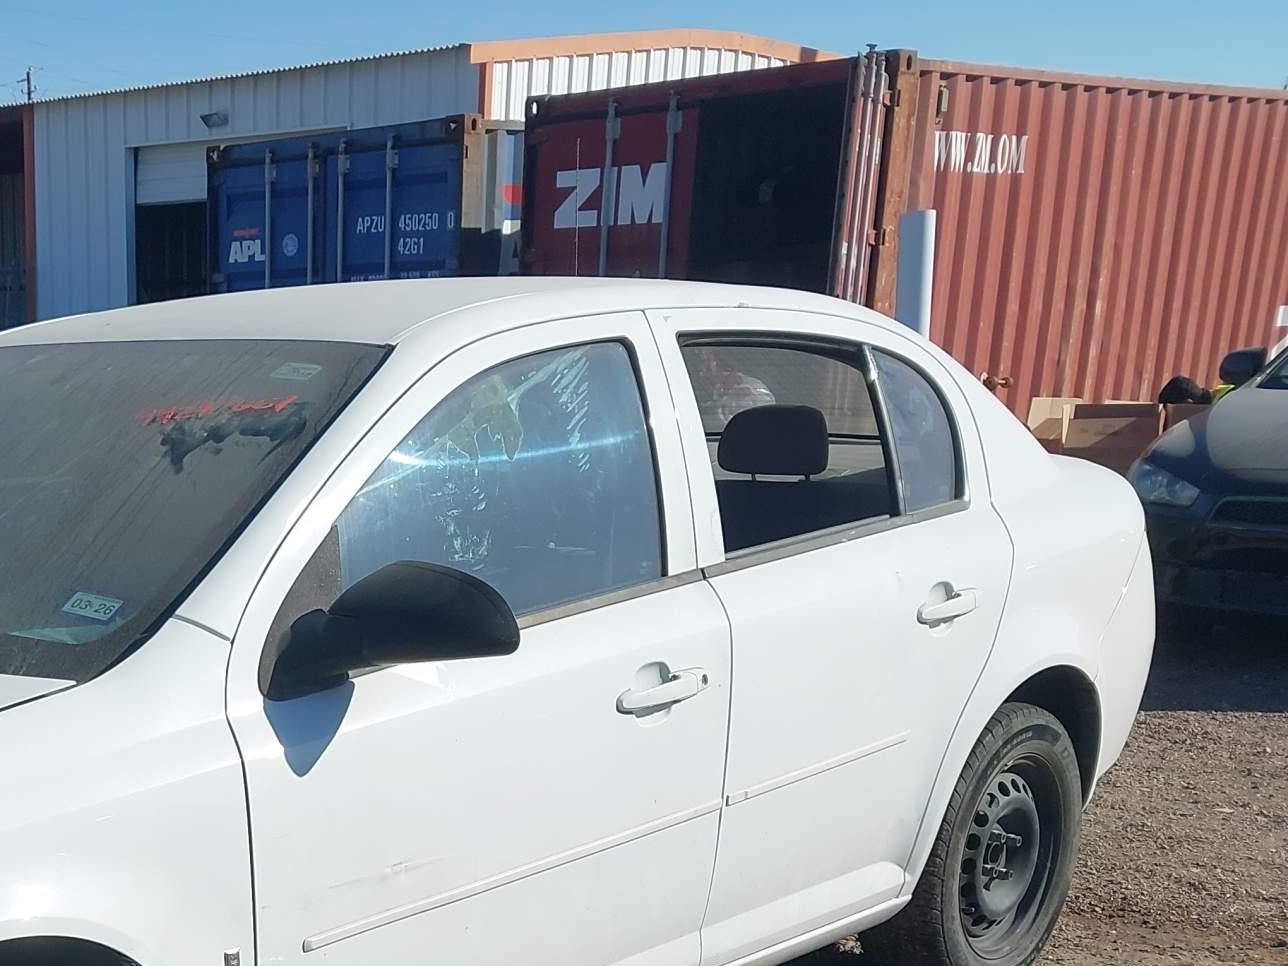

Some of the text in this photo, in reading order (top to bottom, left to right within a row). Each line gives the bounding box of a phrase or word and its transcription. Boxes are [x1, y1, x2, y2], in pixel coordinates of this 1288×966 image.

[553, 162, 668, 229] ZIM
[356, 215, 385, 233] APZU
[398, 213, 439, 231] 450250
[228, 239, 266, 263] APL
[397, 237, 424, 255] 42G1
